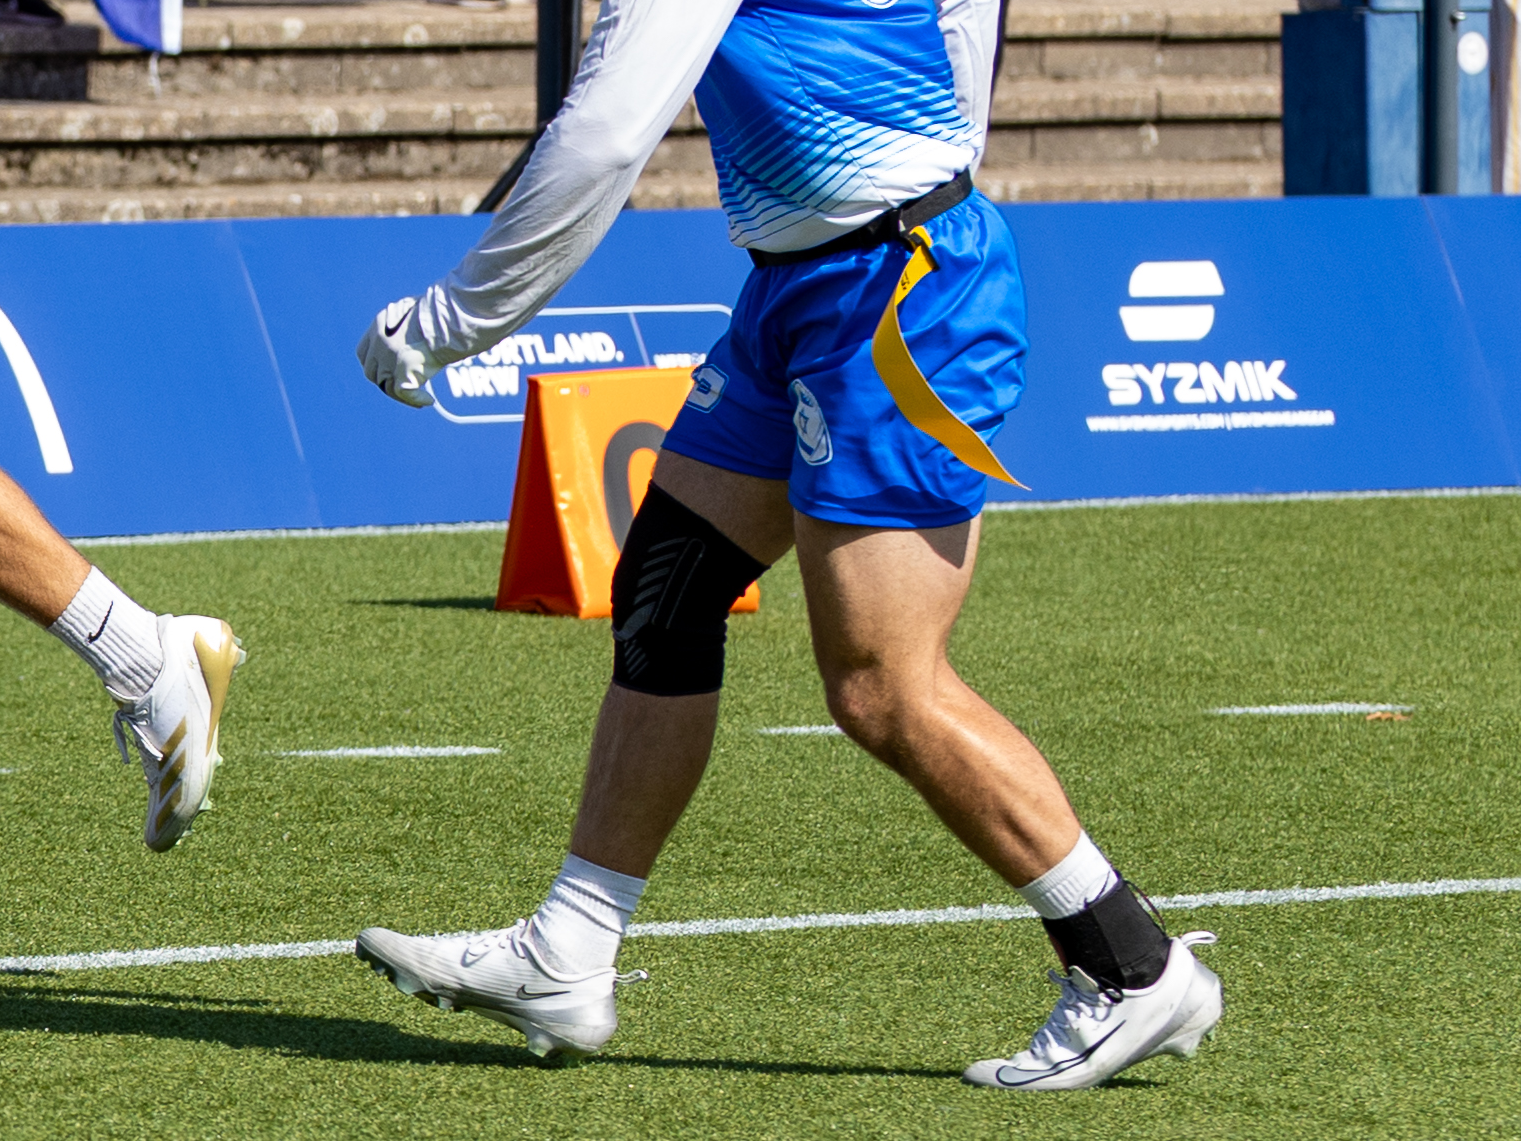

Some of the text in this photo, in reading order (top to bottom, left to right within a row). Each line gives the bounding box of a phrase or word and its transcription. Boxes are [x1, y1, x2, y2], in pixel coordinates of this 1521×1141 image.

[447, 331, 625, 368] ORTLAND.
[445, 364, 520, 398] NRW
[1101, 359, 1299, 407] SYZMIK
